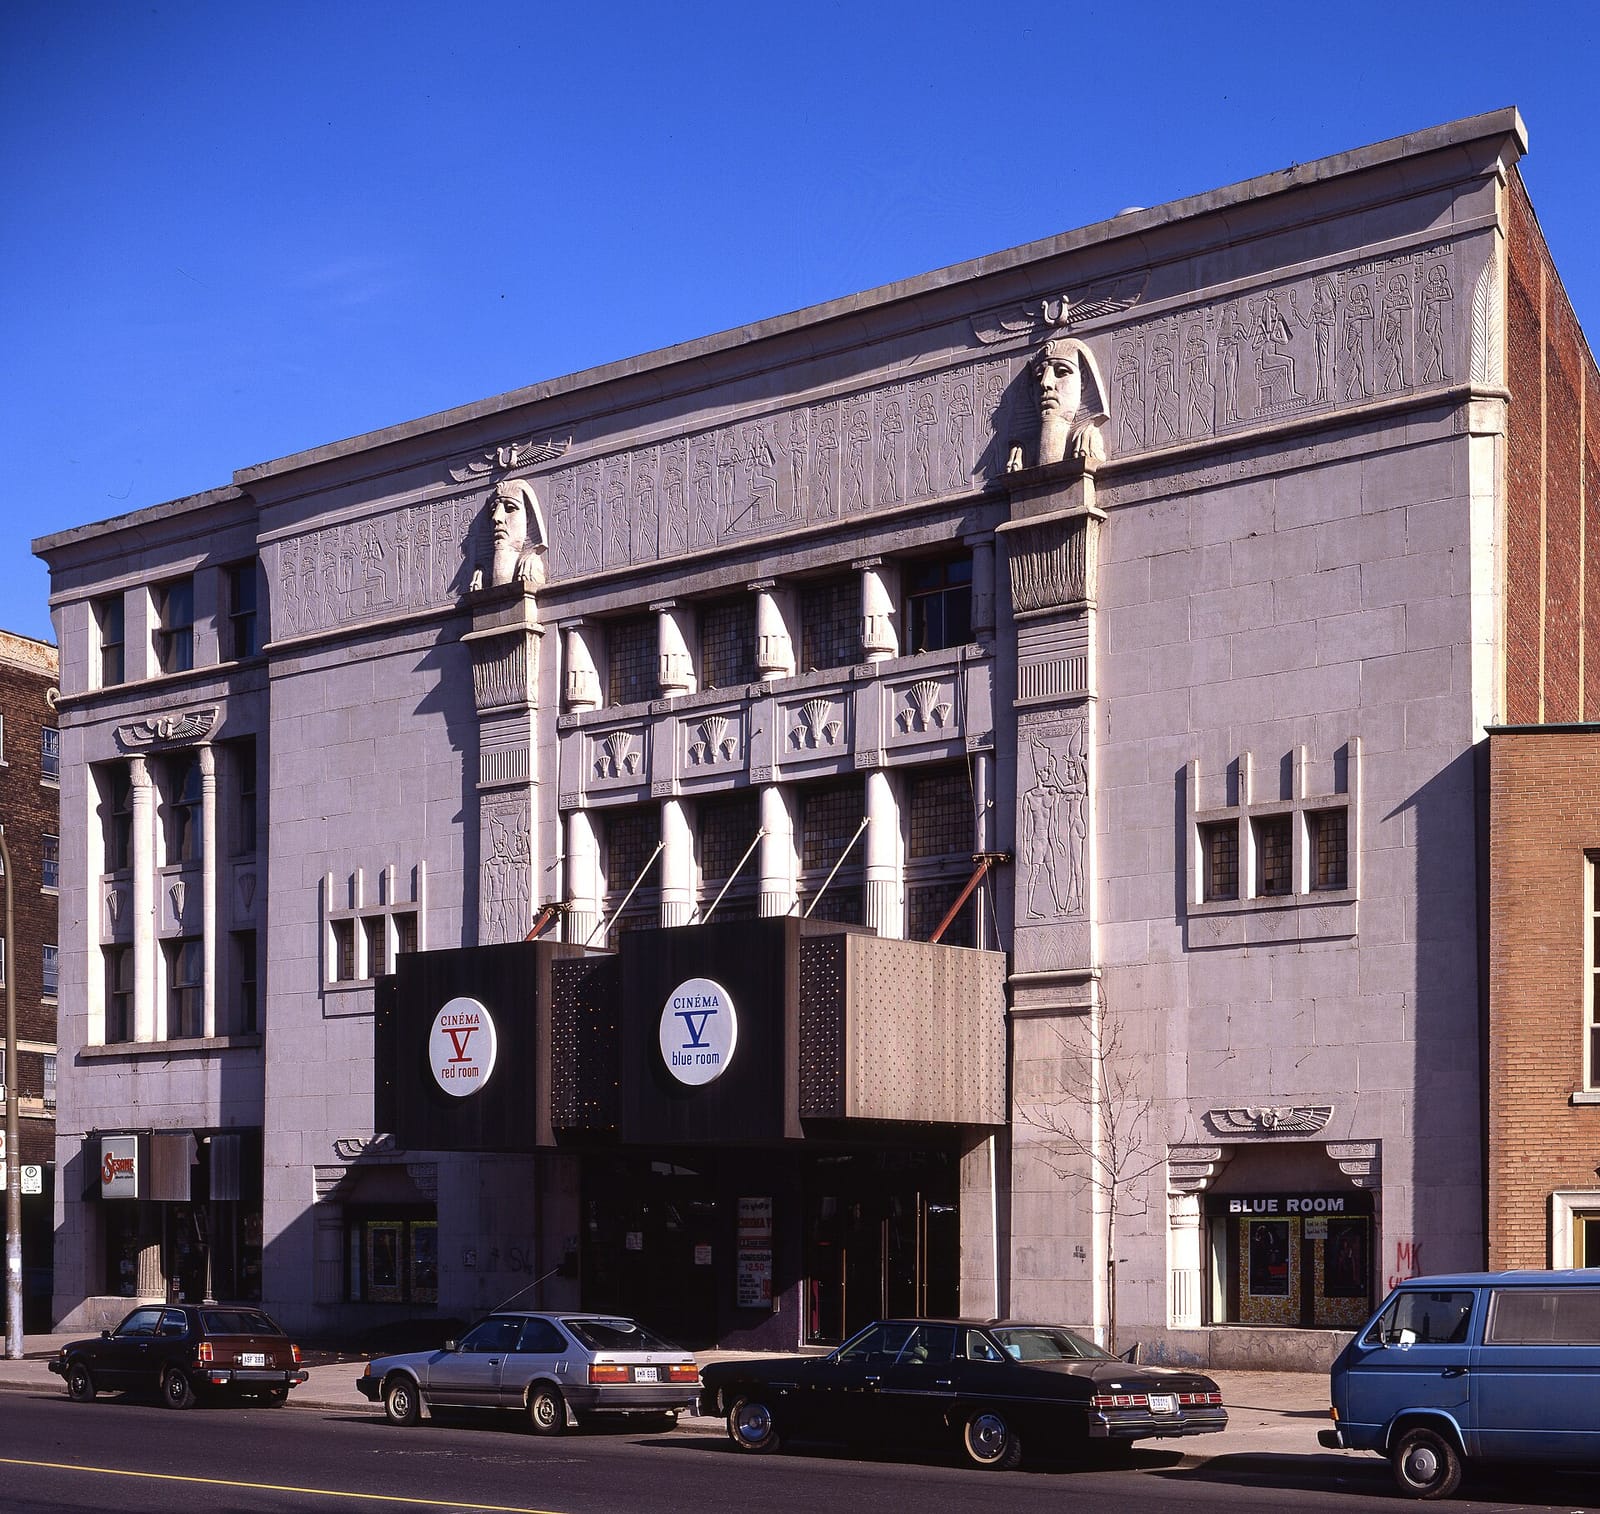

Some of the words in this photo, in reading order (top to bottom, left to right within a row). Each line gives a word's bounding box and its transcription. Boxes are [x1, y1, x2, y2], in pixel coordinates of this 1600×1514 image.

[674, 994, 719, 1009] CINÉMA
[441, 1012, 480, 1025] CINÉMA
[674, 1010, 717, 1048] V
[442, 1027, 479, 1062] V
[672, 1051, 692, 1065] blue
[696, 1053, 719, 1064] room
[442, 1065, 455, 1078] red
[459, 1067, 479, 1077] room
[1230, 1200, 1278, 1212] BLUE
[1287, 1198, 1344, 1212] ROOM
[1397, 1242, 1422, 1275] MK
